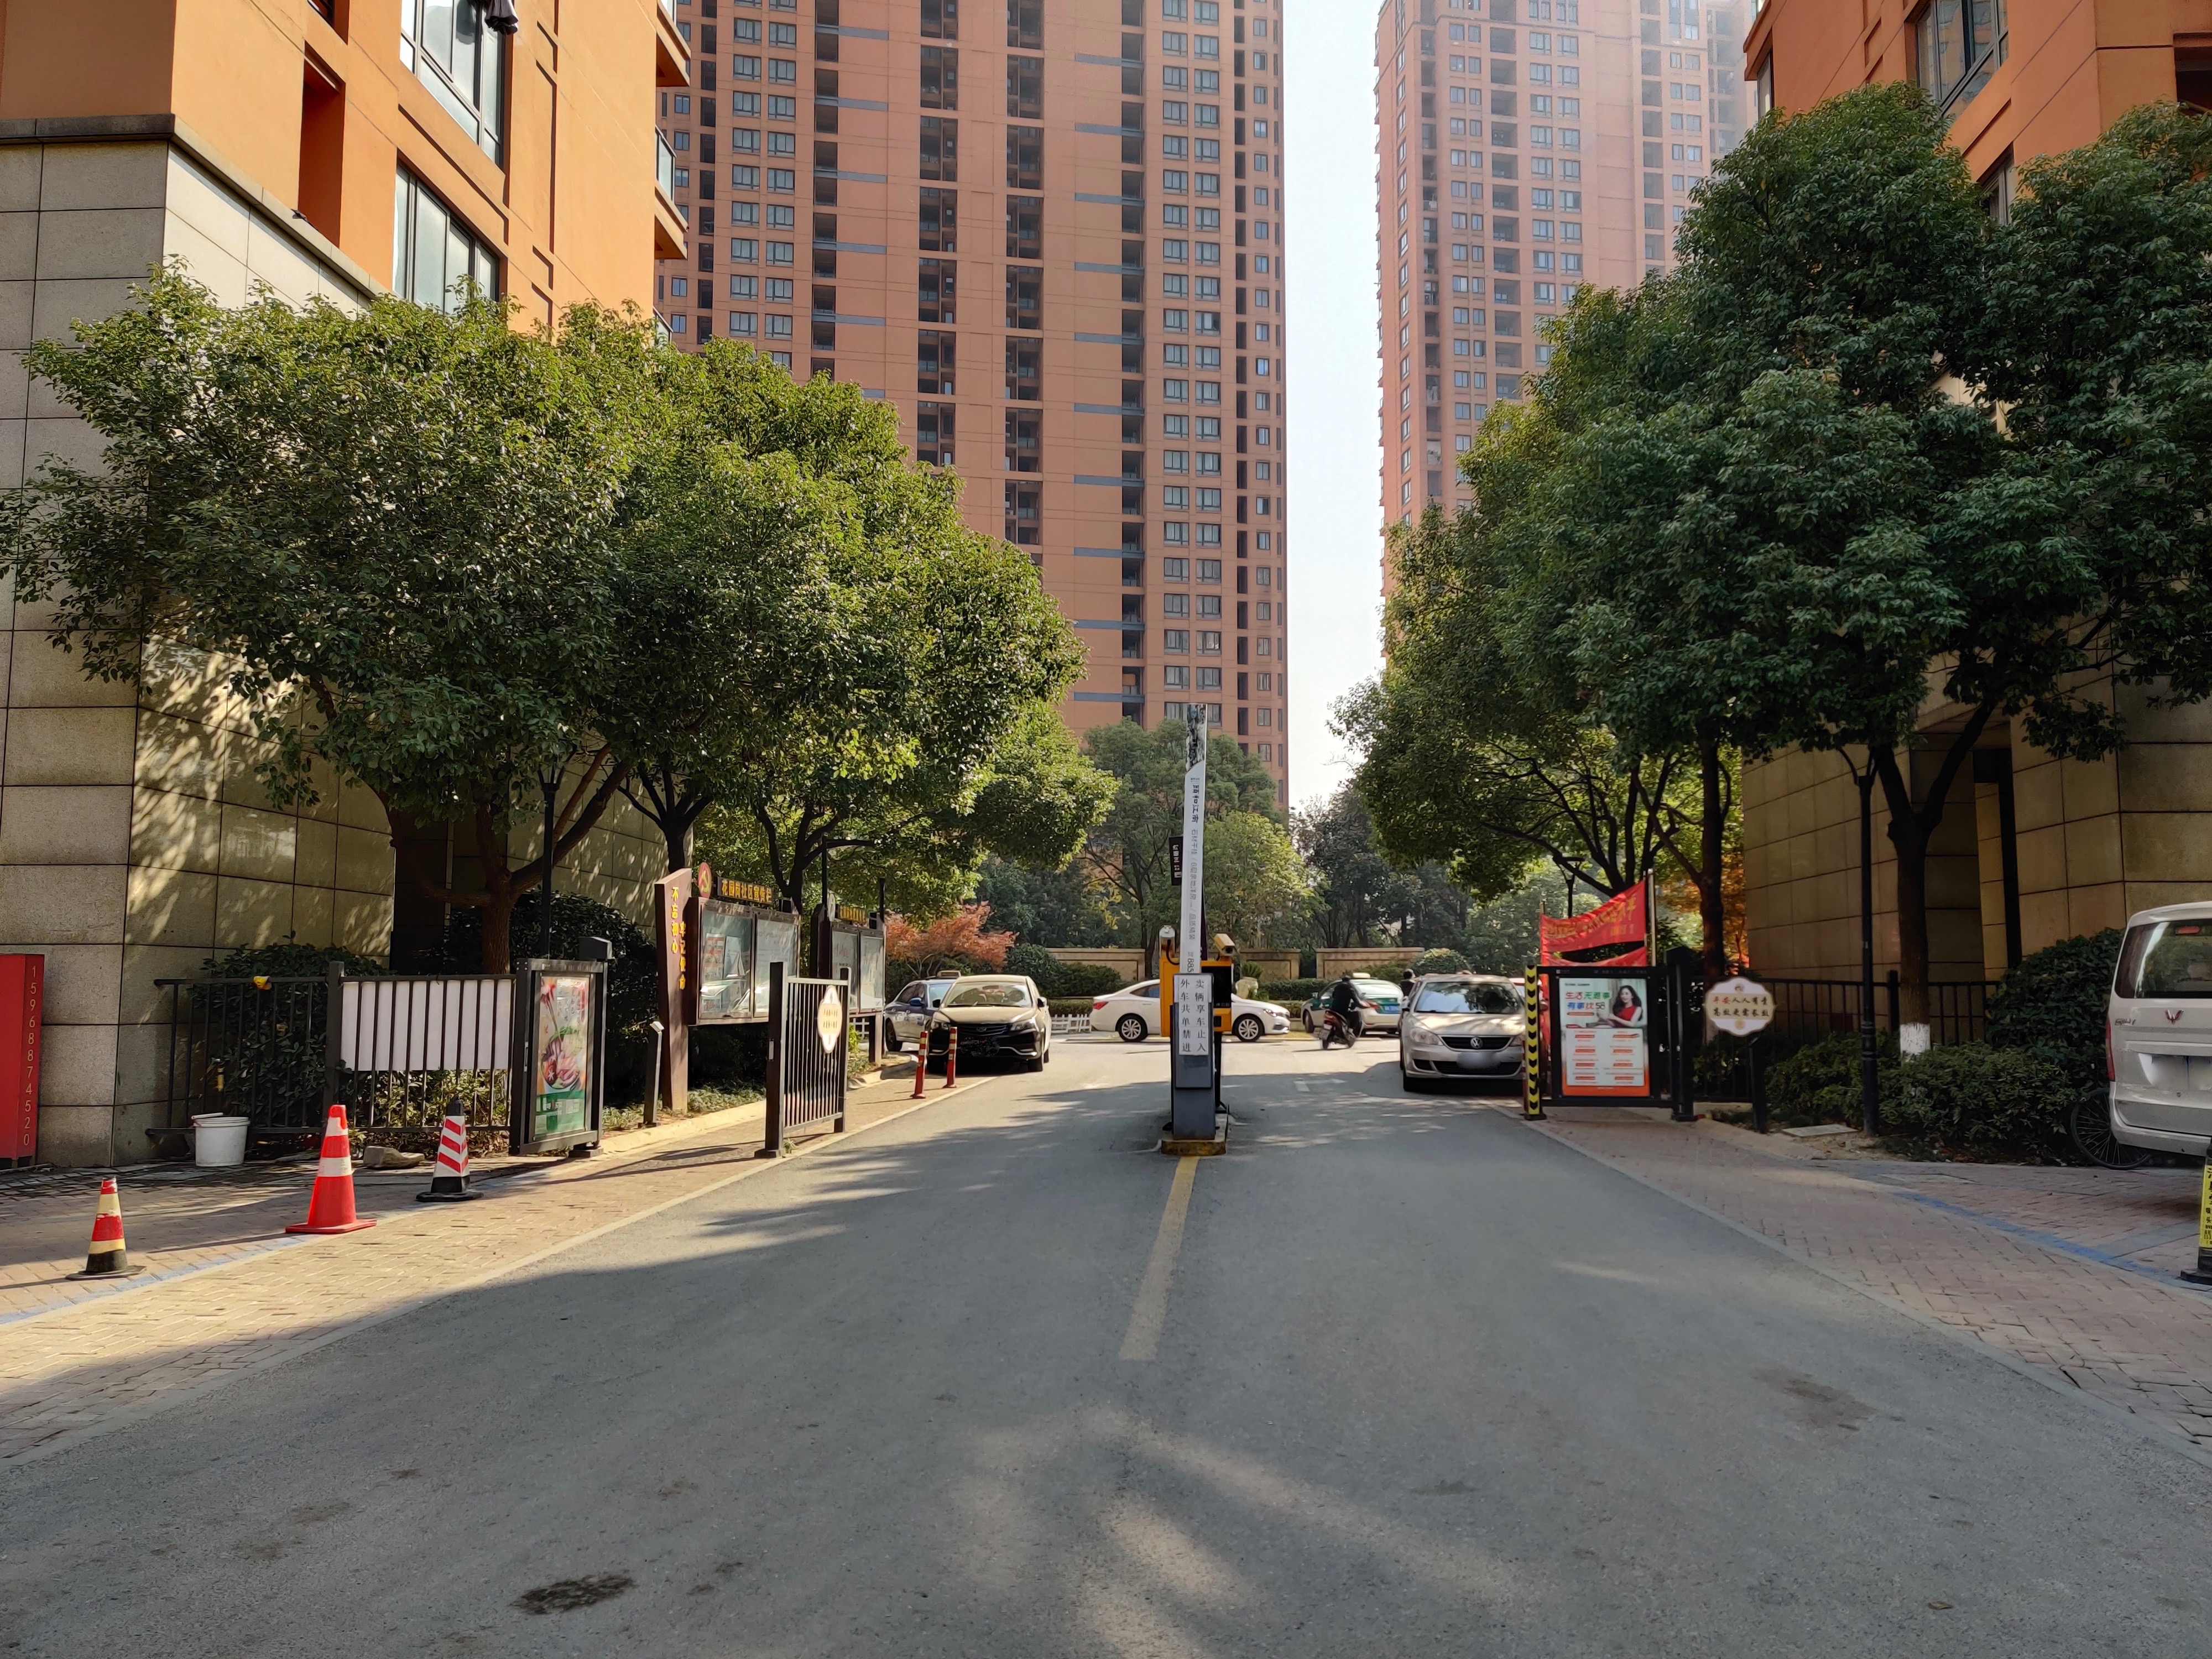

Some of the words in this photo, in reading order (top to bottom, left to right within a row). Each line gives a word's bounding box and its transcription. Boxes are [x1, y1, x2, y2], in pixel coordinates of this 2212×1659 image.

[671, 886, 679, 954] 不忘初心
[23, 965, 36, 1146] 15968874520
